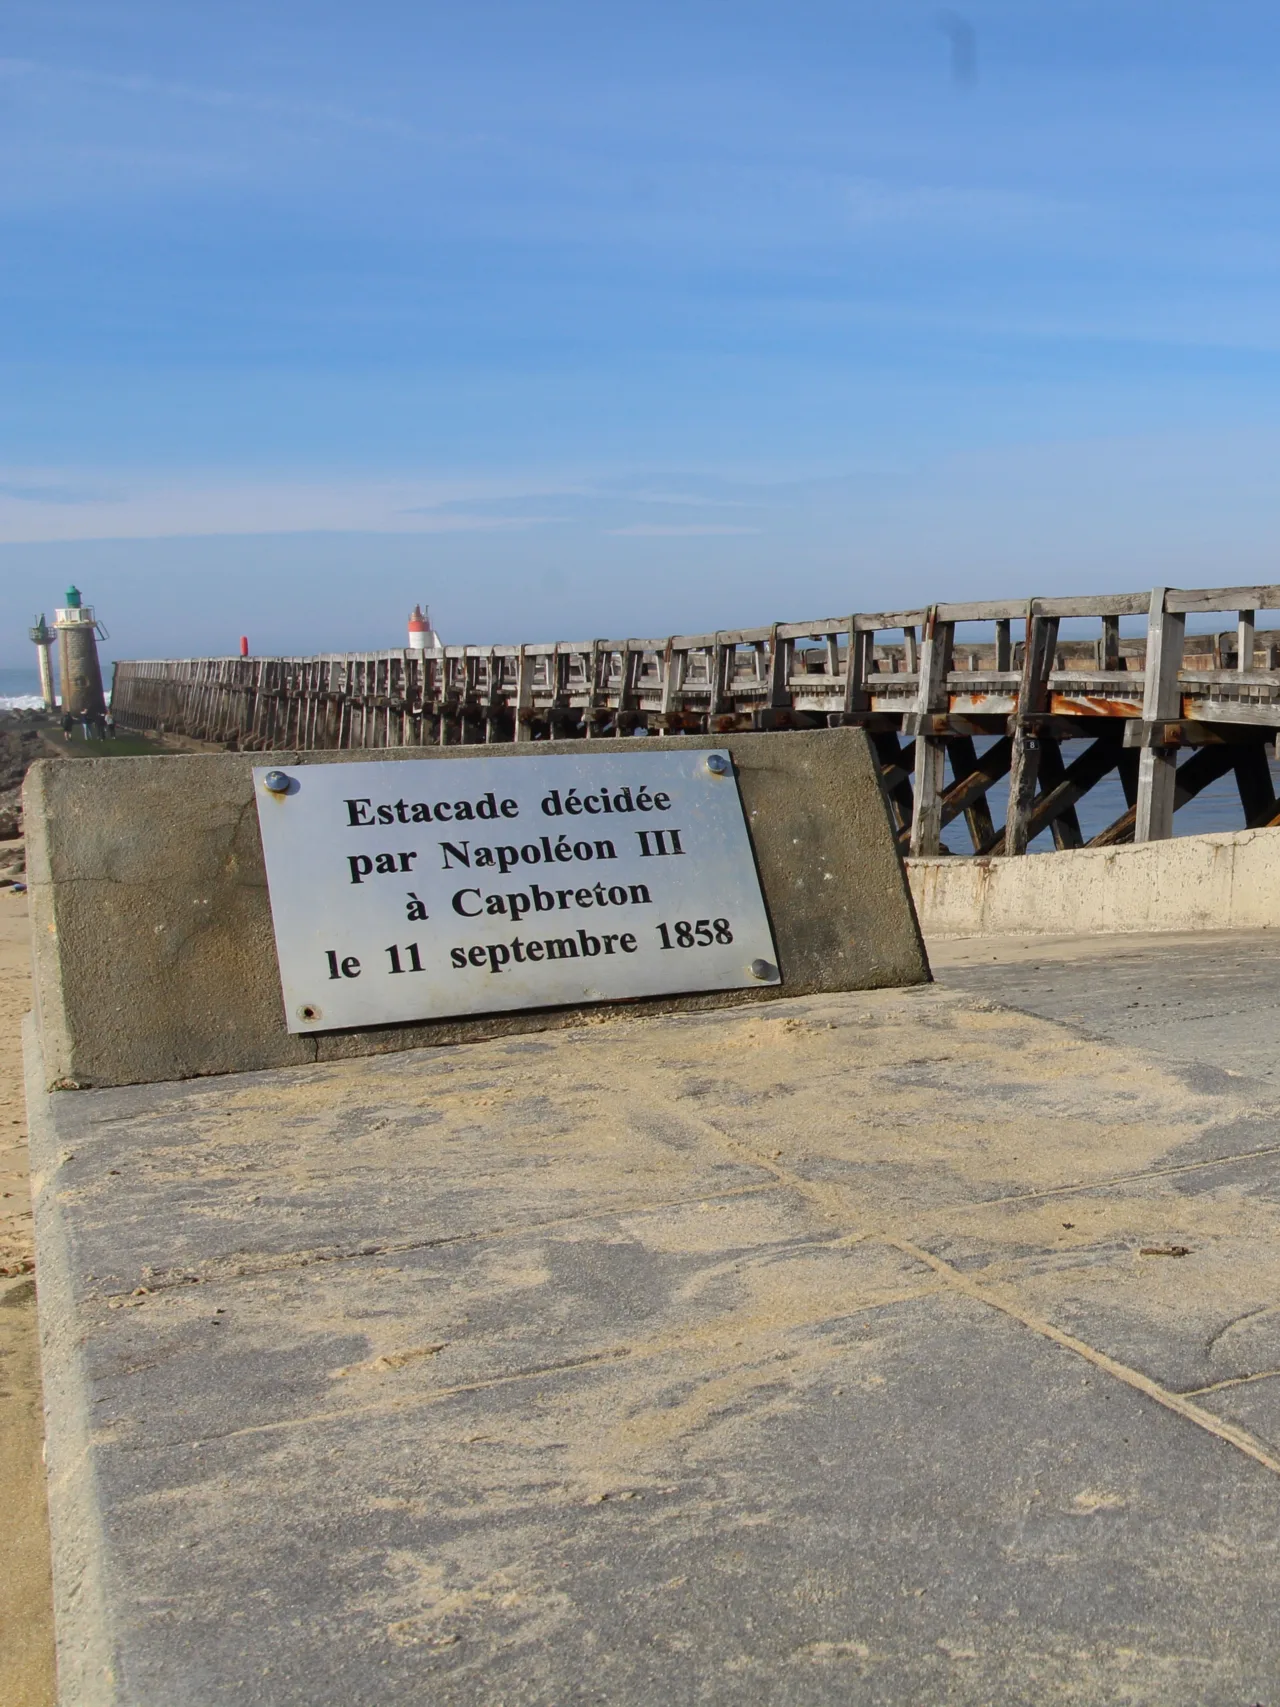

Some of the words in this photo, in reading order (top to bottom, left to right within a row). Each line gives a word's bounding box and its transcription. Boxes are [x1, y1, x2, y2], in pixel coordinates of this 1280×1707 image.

[345, 792, 520, 828] Estacade
[541, 786, 672, 817] décidée
[347, 848, 418, 884] par
[439, 834, 618, 874] Napoléon
[634, 829, 686, 858] III
[406, 892, 429, 922] à
[451, 882, 653, 922] Capbreton
[325, 950, 362, 980] le
[384, 942, 426, 976] 11
[451, 926, 638, 975] septembre
[656, 917, 734, 952] 1858
